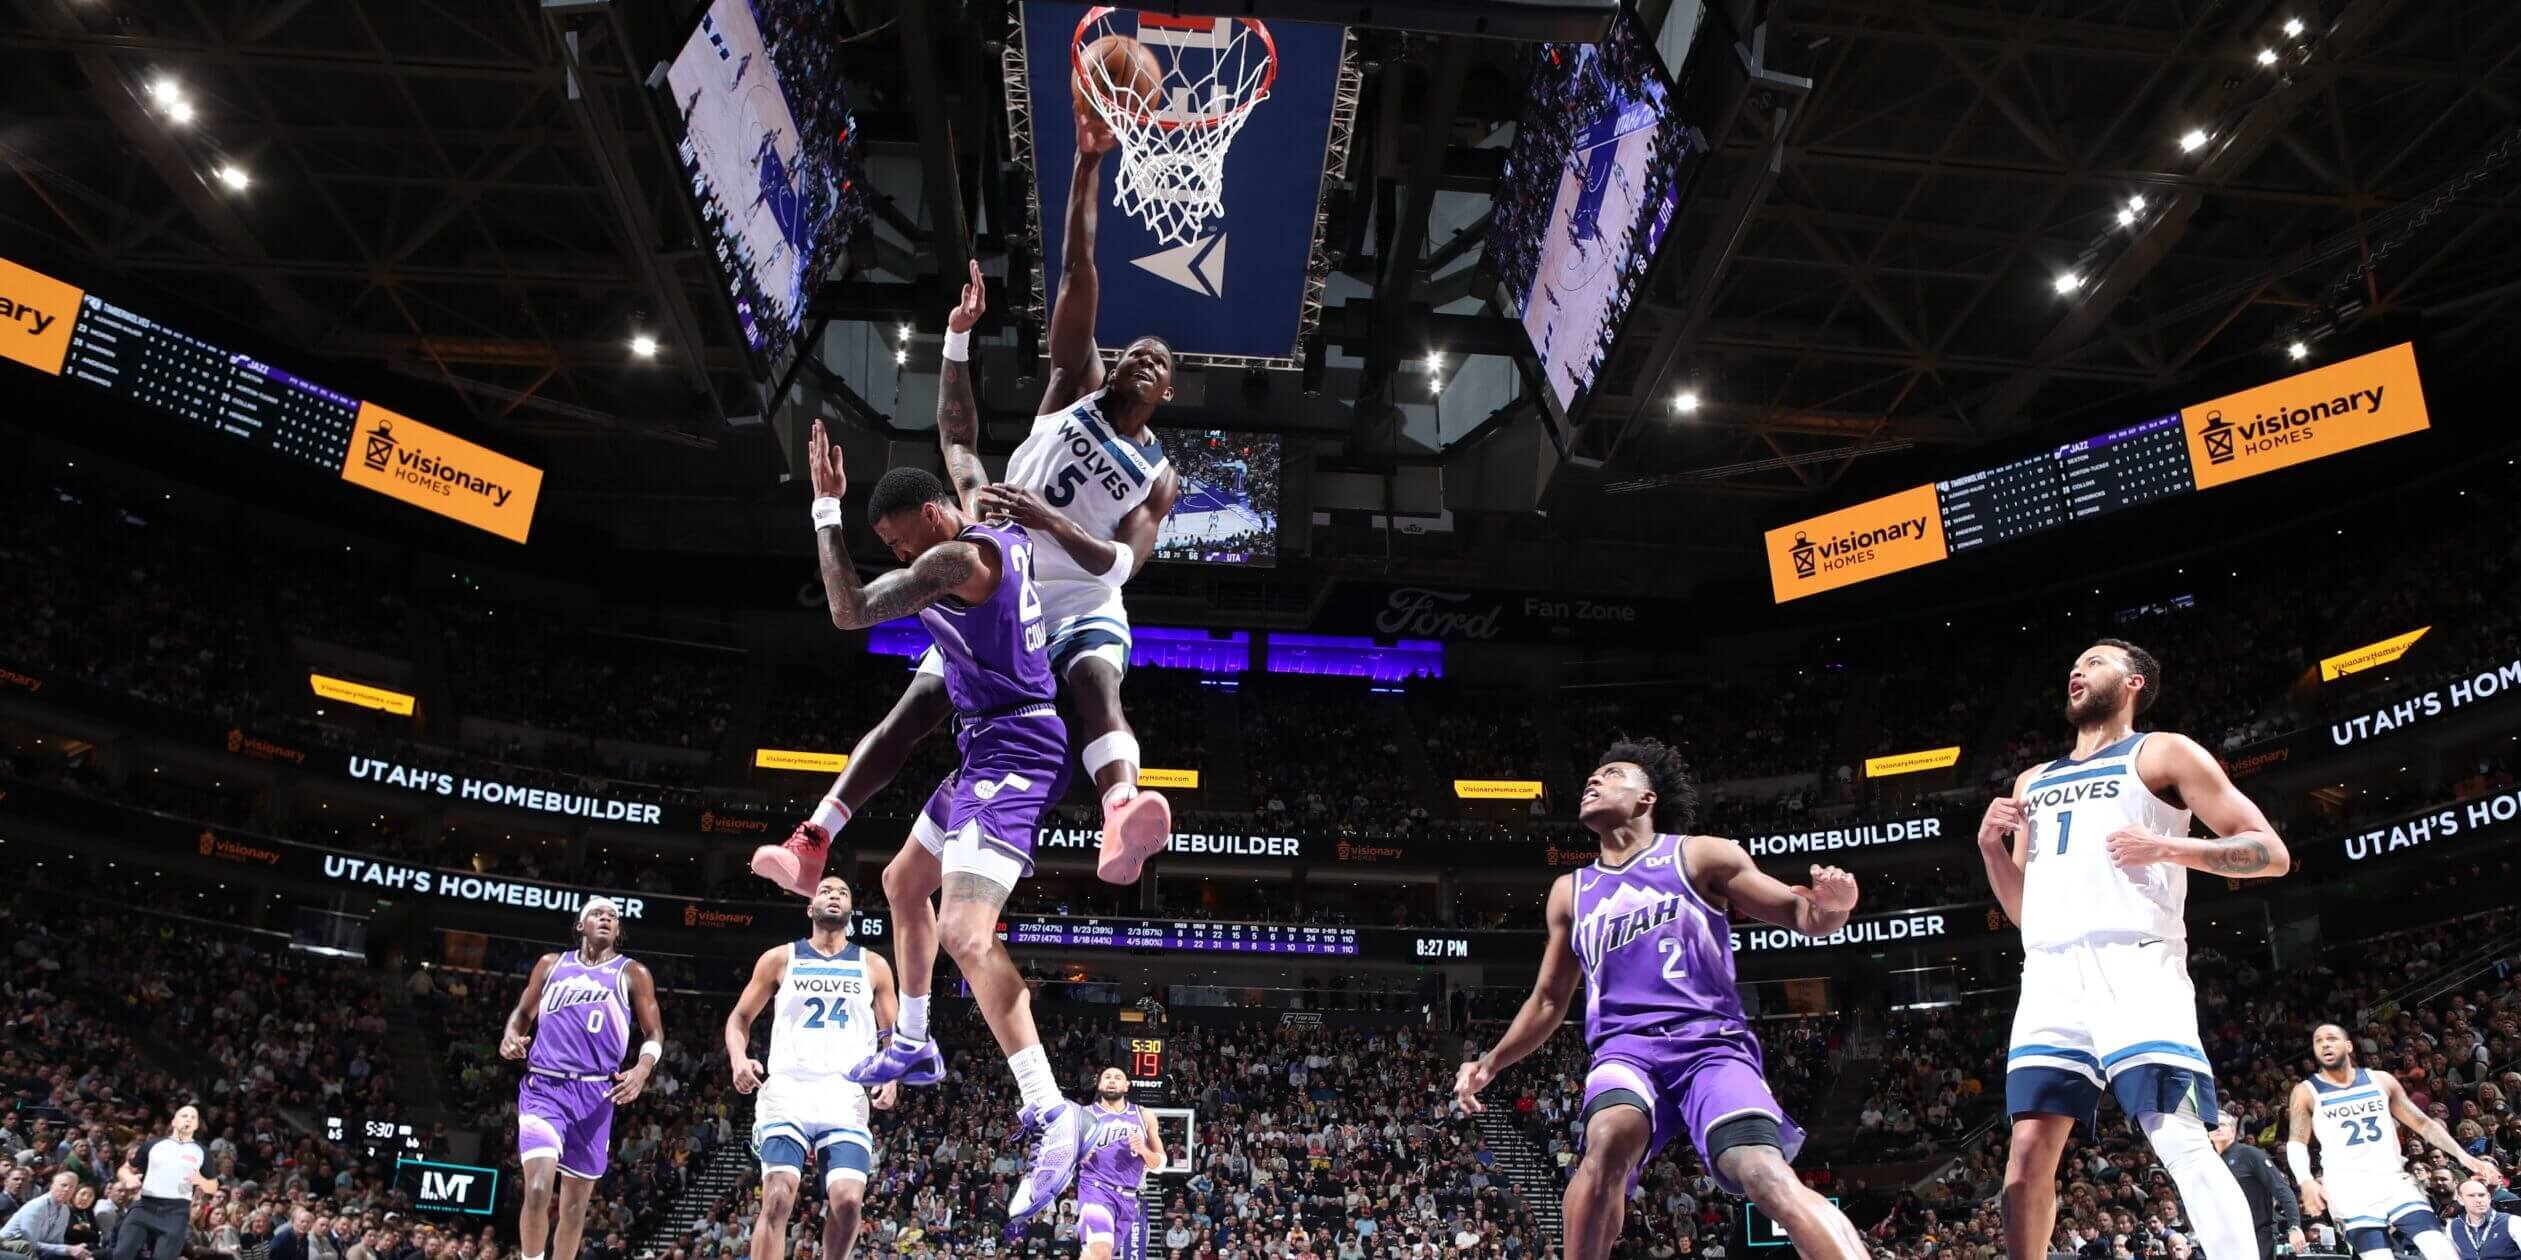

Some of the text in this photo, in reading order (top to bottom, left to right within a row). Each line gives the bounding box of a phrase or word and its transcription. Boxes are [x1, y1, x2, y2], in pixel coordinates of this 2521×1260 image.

[2238, 385, 2384, 440] visionary
[2069, 440, 2089, 453] JAZZ
[2245, 427, 2314, 456] HOMES
[1058, 420, 1130, 501] WOLVES
[394, 467, 451, 497] HOMES
[398, 447, 512, 507] visionary
[1045, 464, 1087, 508] 5
[1818, 516, 1927, 558] visionary
[1227, 554, 1241, 562] UTA
[1824, 550, 1875, 572] HOMES
[1376, 587, 1502, 639] Ford
[1524, 597, 1635, 621] Fan Zone
[2331, 692, 2441, 746] UTAH'S
[244, 738, 304, 763] visionary
[766, 755, 838, 766] VisionaryHomes.com
[1875, 754, 1951, 771] VisionaryHomes.com
[349, 756, 662, 824] UTAH'S HOMEBUILDER
[1463, 785, 1533, 794] VisionaryHomes.com
[2028, 780, 2120, 811] WOLVES
[715, 816, 768, 831] visionary
[2057, 810, 2072, 855] 1
[2345, 791, 2521, 860] UTAH'S HO
[1750, 818, 1941, 856] HOMEBUILDER
[216, 840, 280, 864] visionary
[1351, 845, 1402, 860] visionary
[324, 855, 644, 919] UTAH'S HOMEBUILER
[700, 911, 753, 926] visionary
[862, 919, 882, 935] 65
[1018, 934, 1040, 942] 27/57
[1041, 935, 1062, 943] (47%)
[1126, 938, 1140, 946] 4/5
[1194, 940, 1203, 948] 22
[1213, 941, 1222, 949] 31
[1307, 944, 1315, 952] 17
[1323, 945, 1335, 953] 110
[1019, 924, 1041, 932] 27/57
[1043, 925, 1063, 933] (47%)
[1306, 934, 1316, 942] 24
[1324, 935, 1335, 943] 110
[1580, 897, 1681, 974] UTAH
[1416, 939, 1467, 957] 8:27 PM
[1658, 937, 1688, 979] 2
[794, 979, 860, 994] WOLVES
[547, 985, 613, 1013] UTAH
[587, 1010, 604, 1033] 0
[803, 997, 849, 1029] 24
[1132, 1040, 1161, 1053] 5:30
[1135, 1053, 1158, 1076] 19
[1131, 1080, 1163, 1088] TISSOT
[2323, 1100, 2384, 1119] WOLVES
[327, 1129, 343, 1140] 65
[365, 1121, 395, 1138] 5:30
[2341, 1116, 2382, 1146] 23
[420, 1171, 475, 1203] LVT
